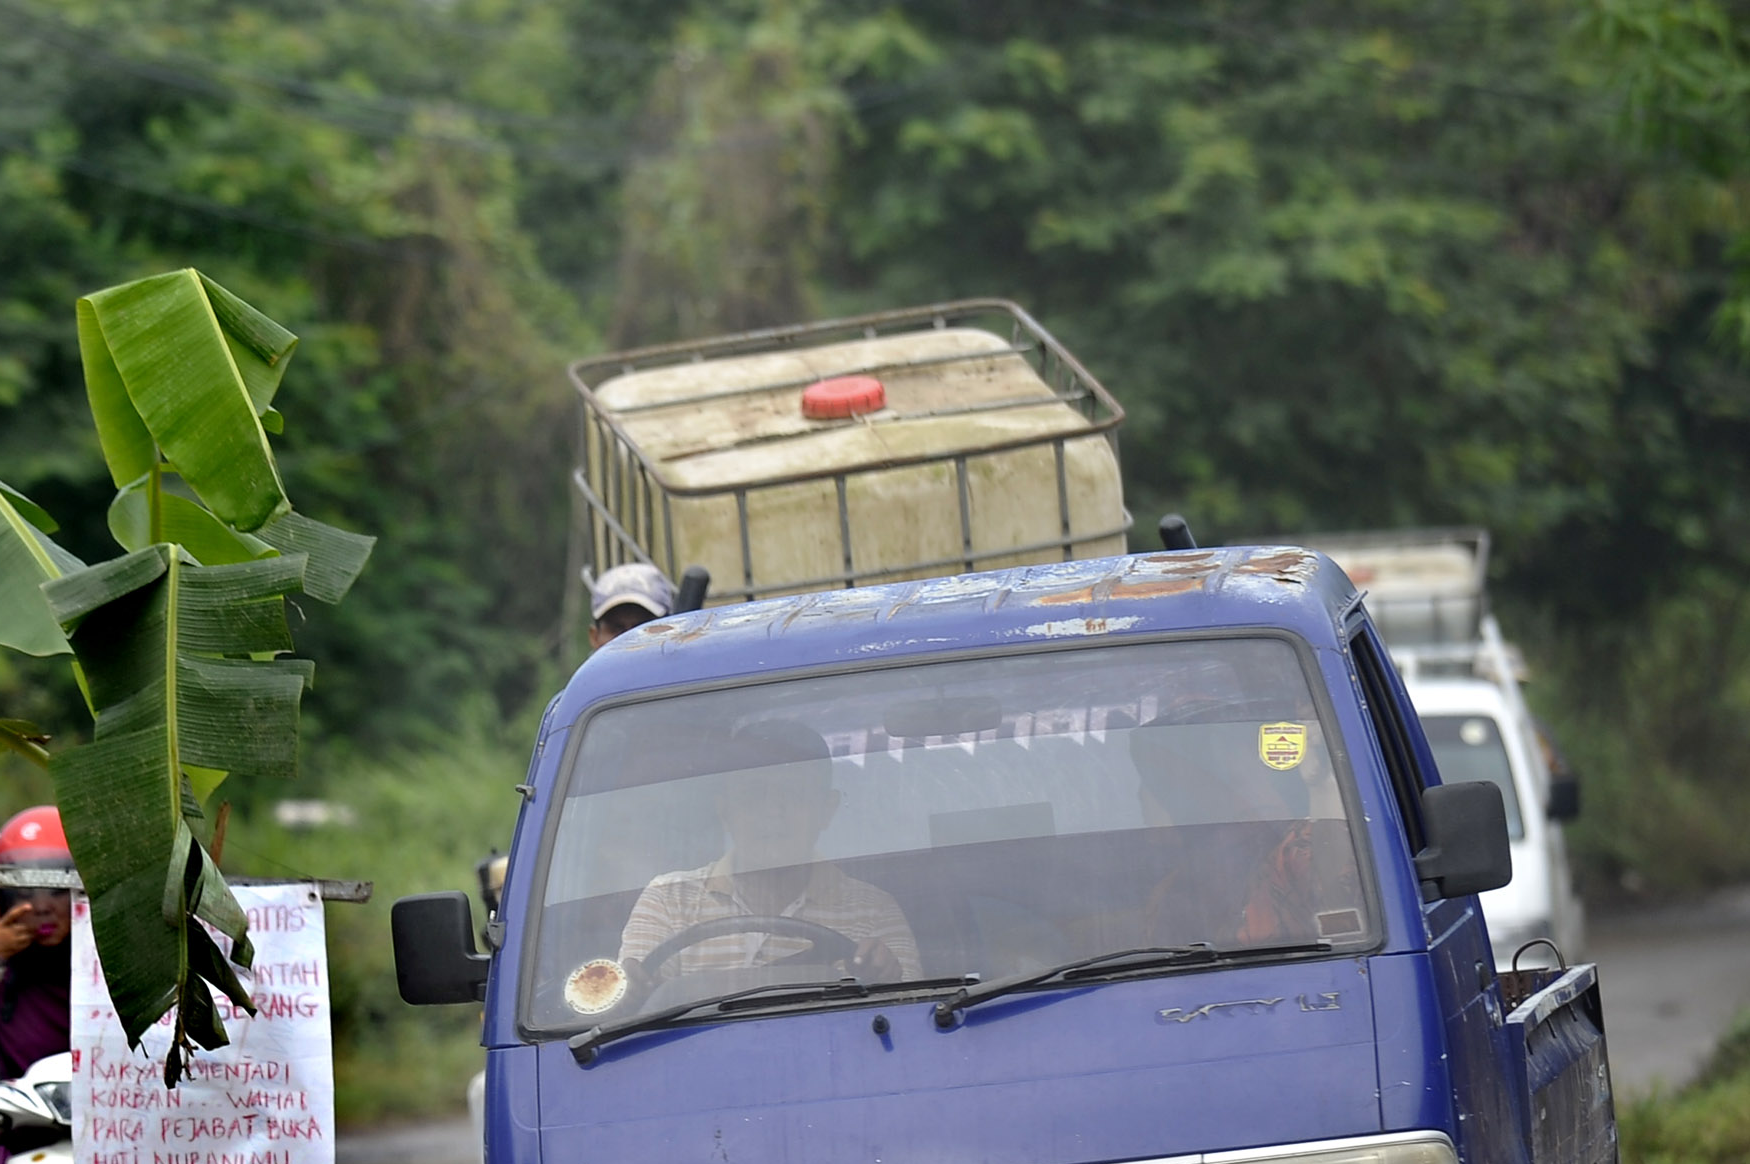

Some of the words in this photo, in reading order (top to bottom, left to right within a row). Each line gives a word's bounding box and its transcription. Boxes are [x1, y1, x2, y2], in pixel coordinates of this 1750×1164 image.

[93, 1117, 144, 1143] PARA
[161, 1113, 262, 1143] PEJABAT
[265, 1115, 323, 1141] BUKA
